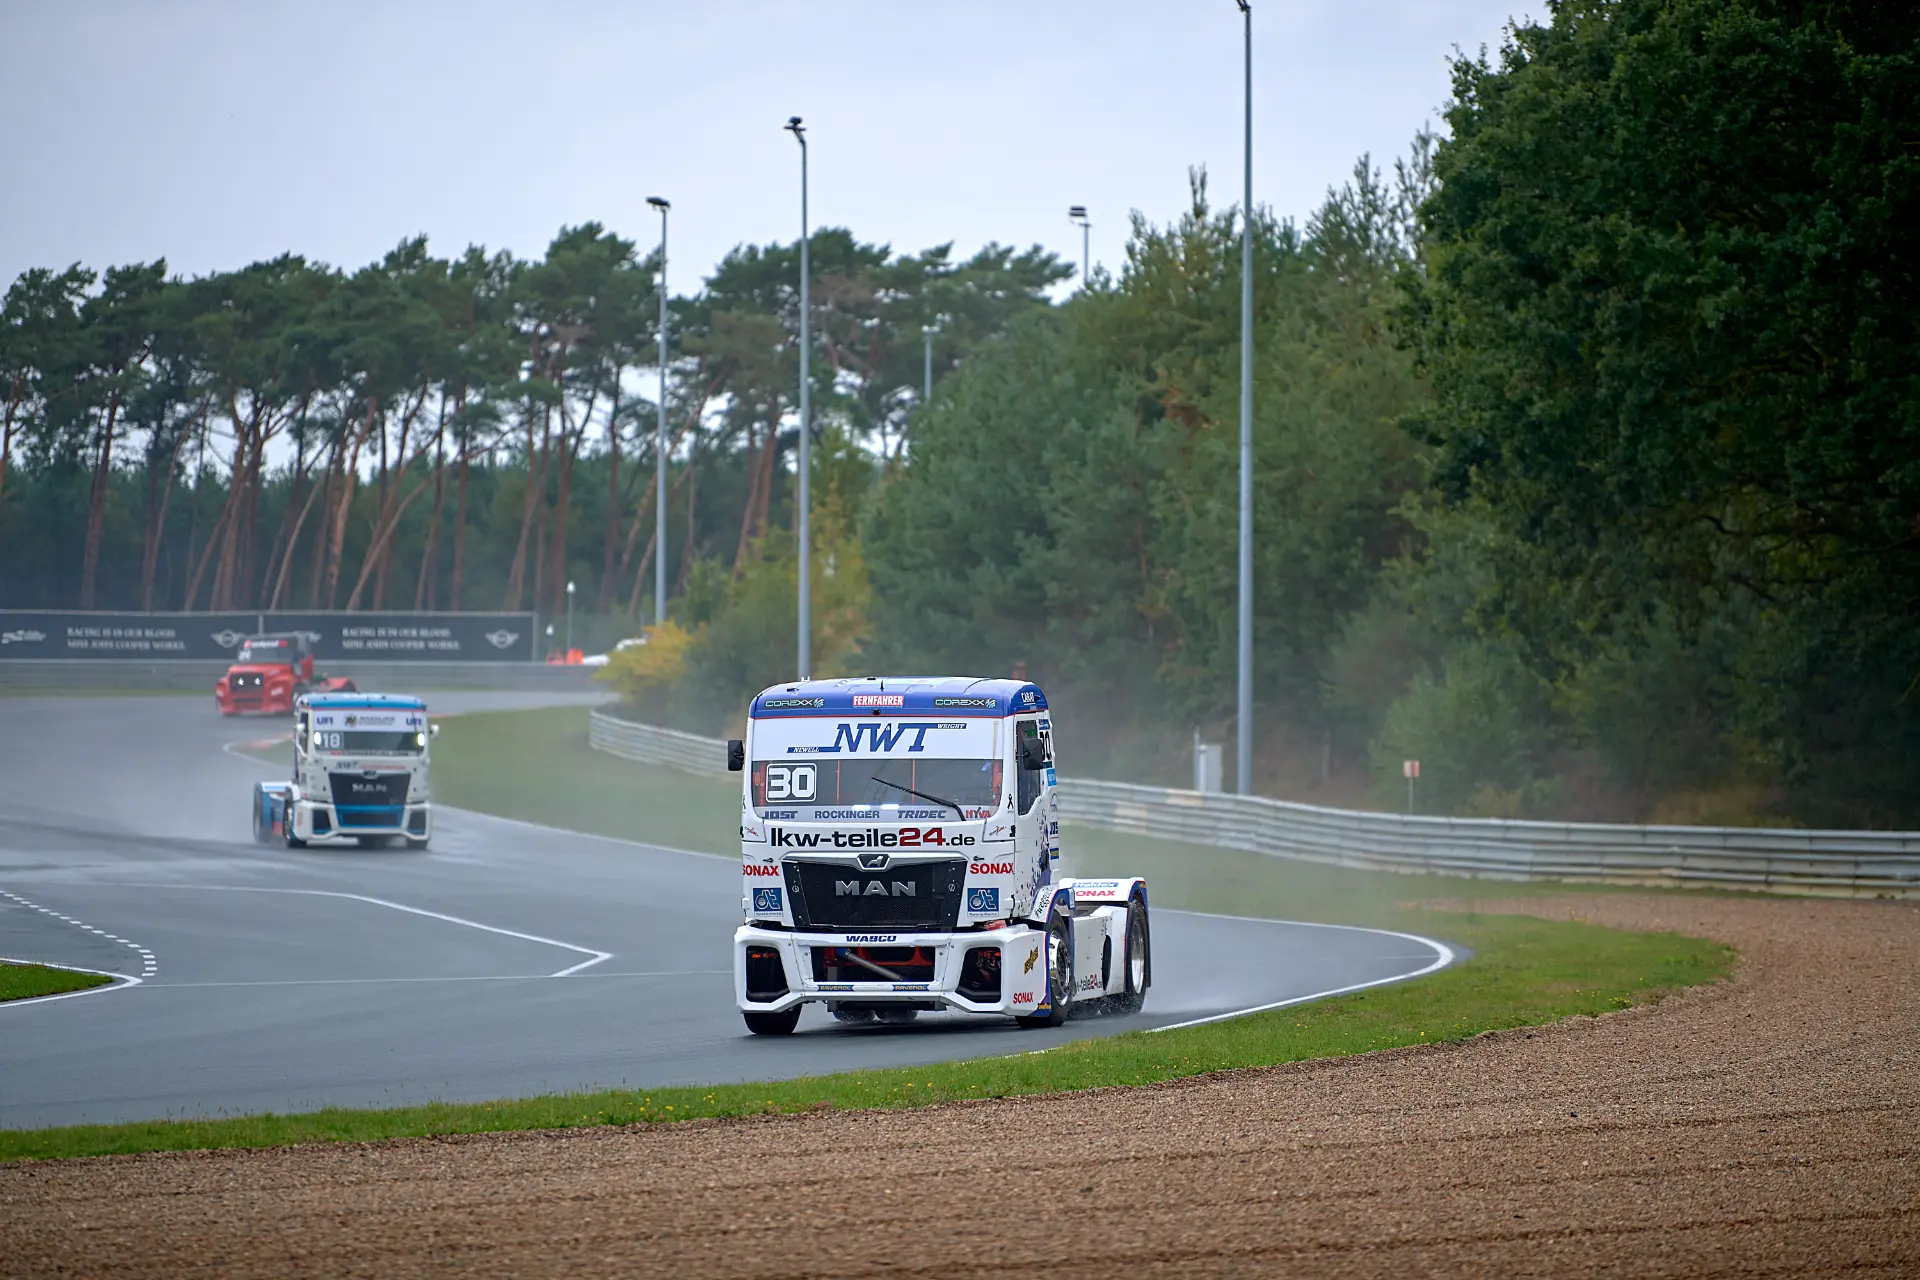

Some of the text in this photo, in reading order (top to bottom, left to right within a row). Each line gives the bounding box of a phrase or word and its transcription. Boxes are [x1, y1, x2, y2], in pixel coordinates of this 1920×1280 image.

[765, 699, 813, 707] COREXX
[853, 695, 903, 706] FERNFAHRER
[934, 699, 985, 707] COREXX
[323, 732, 341, 749] 18
[834, 723, 930, 753] NWT
[768, 767, 815, 798] 30
[762, 810, 799, 820] JOST
[814, 810, 880, 819] ROCKINGER
[897, 809, 947, 819] TRIDEC
[965, 806, 992, 819] HYVA
[771, 827, 976, 848] lkw-teile24.de
[970, 863, 1014, 875] SONAX
[835, 880, 917, 896] MAN
[1013, 991, 1034, 1004] SONAX
